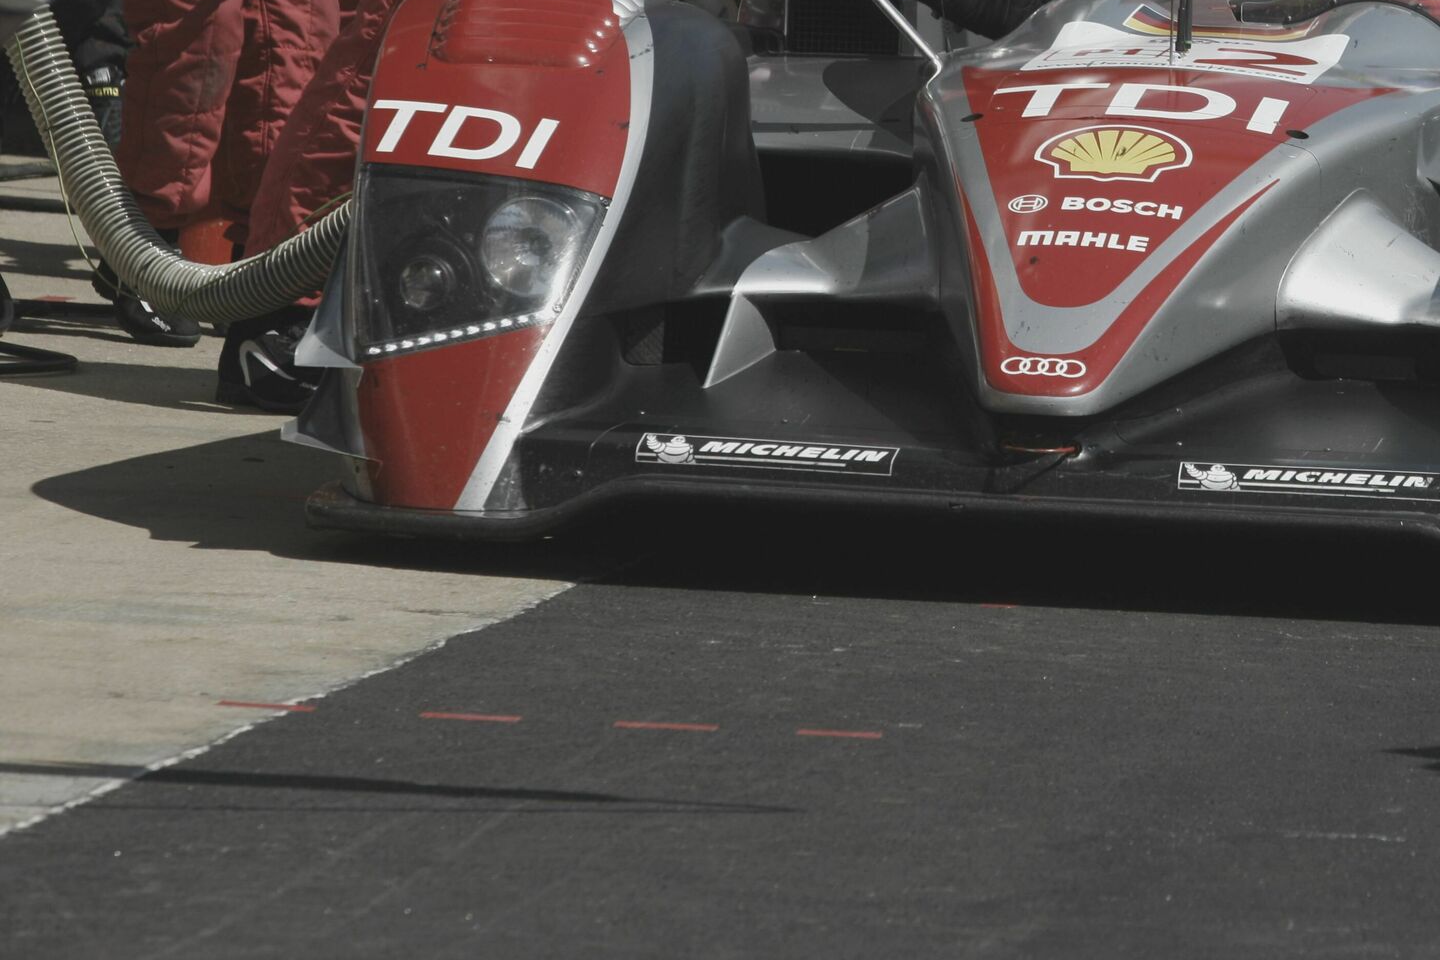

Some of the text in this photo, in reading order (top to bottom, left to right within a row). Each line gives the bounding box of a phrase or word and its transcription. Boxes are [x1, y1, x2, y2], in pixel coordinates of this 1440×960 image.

[1193, 47, 1319, 77] 2
[993, 83, 1290, 134] TDI
[373, 100, 560, 169] TDI
[1061, 197, 1183, 220] BOSCH
[1017, 230, 1149, 252] MAHLE
[699, 439, 889, 462] MICHELIN
[1243, 467, 1433, 489] MICHELIN
